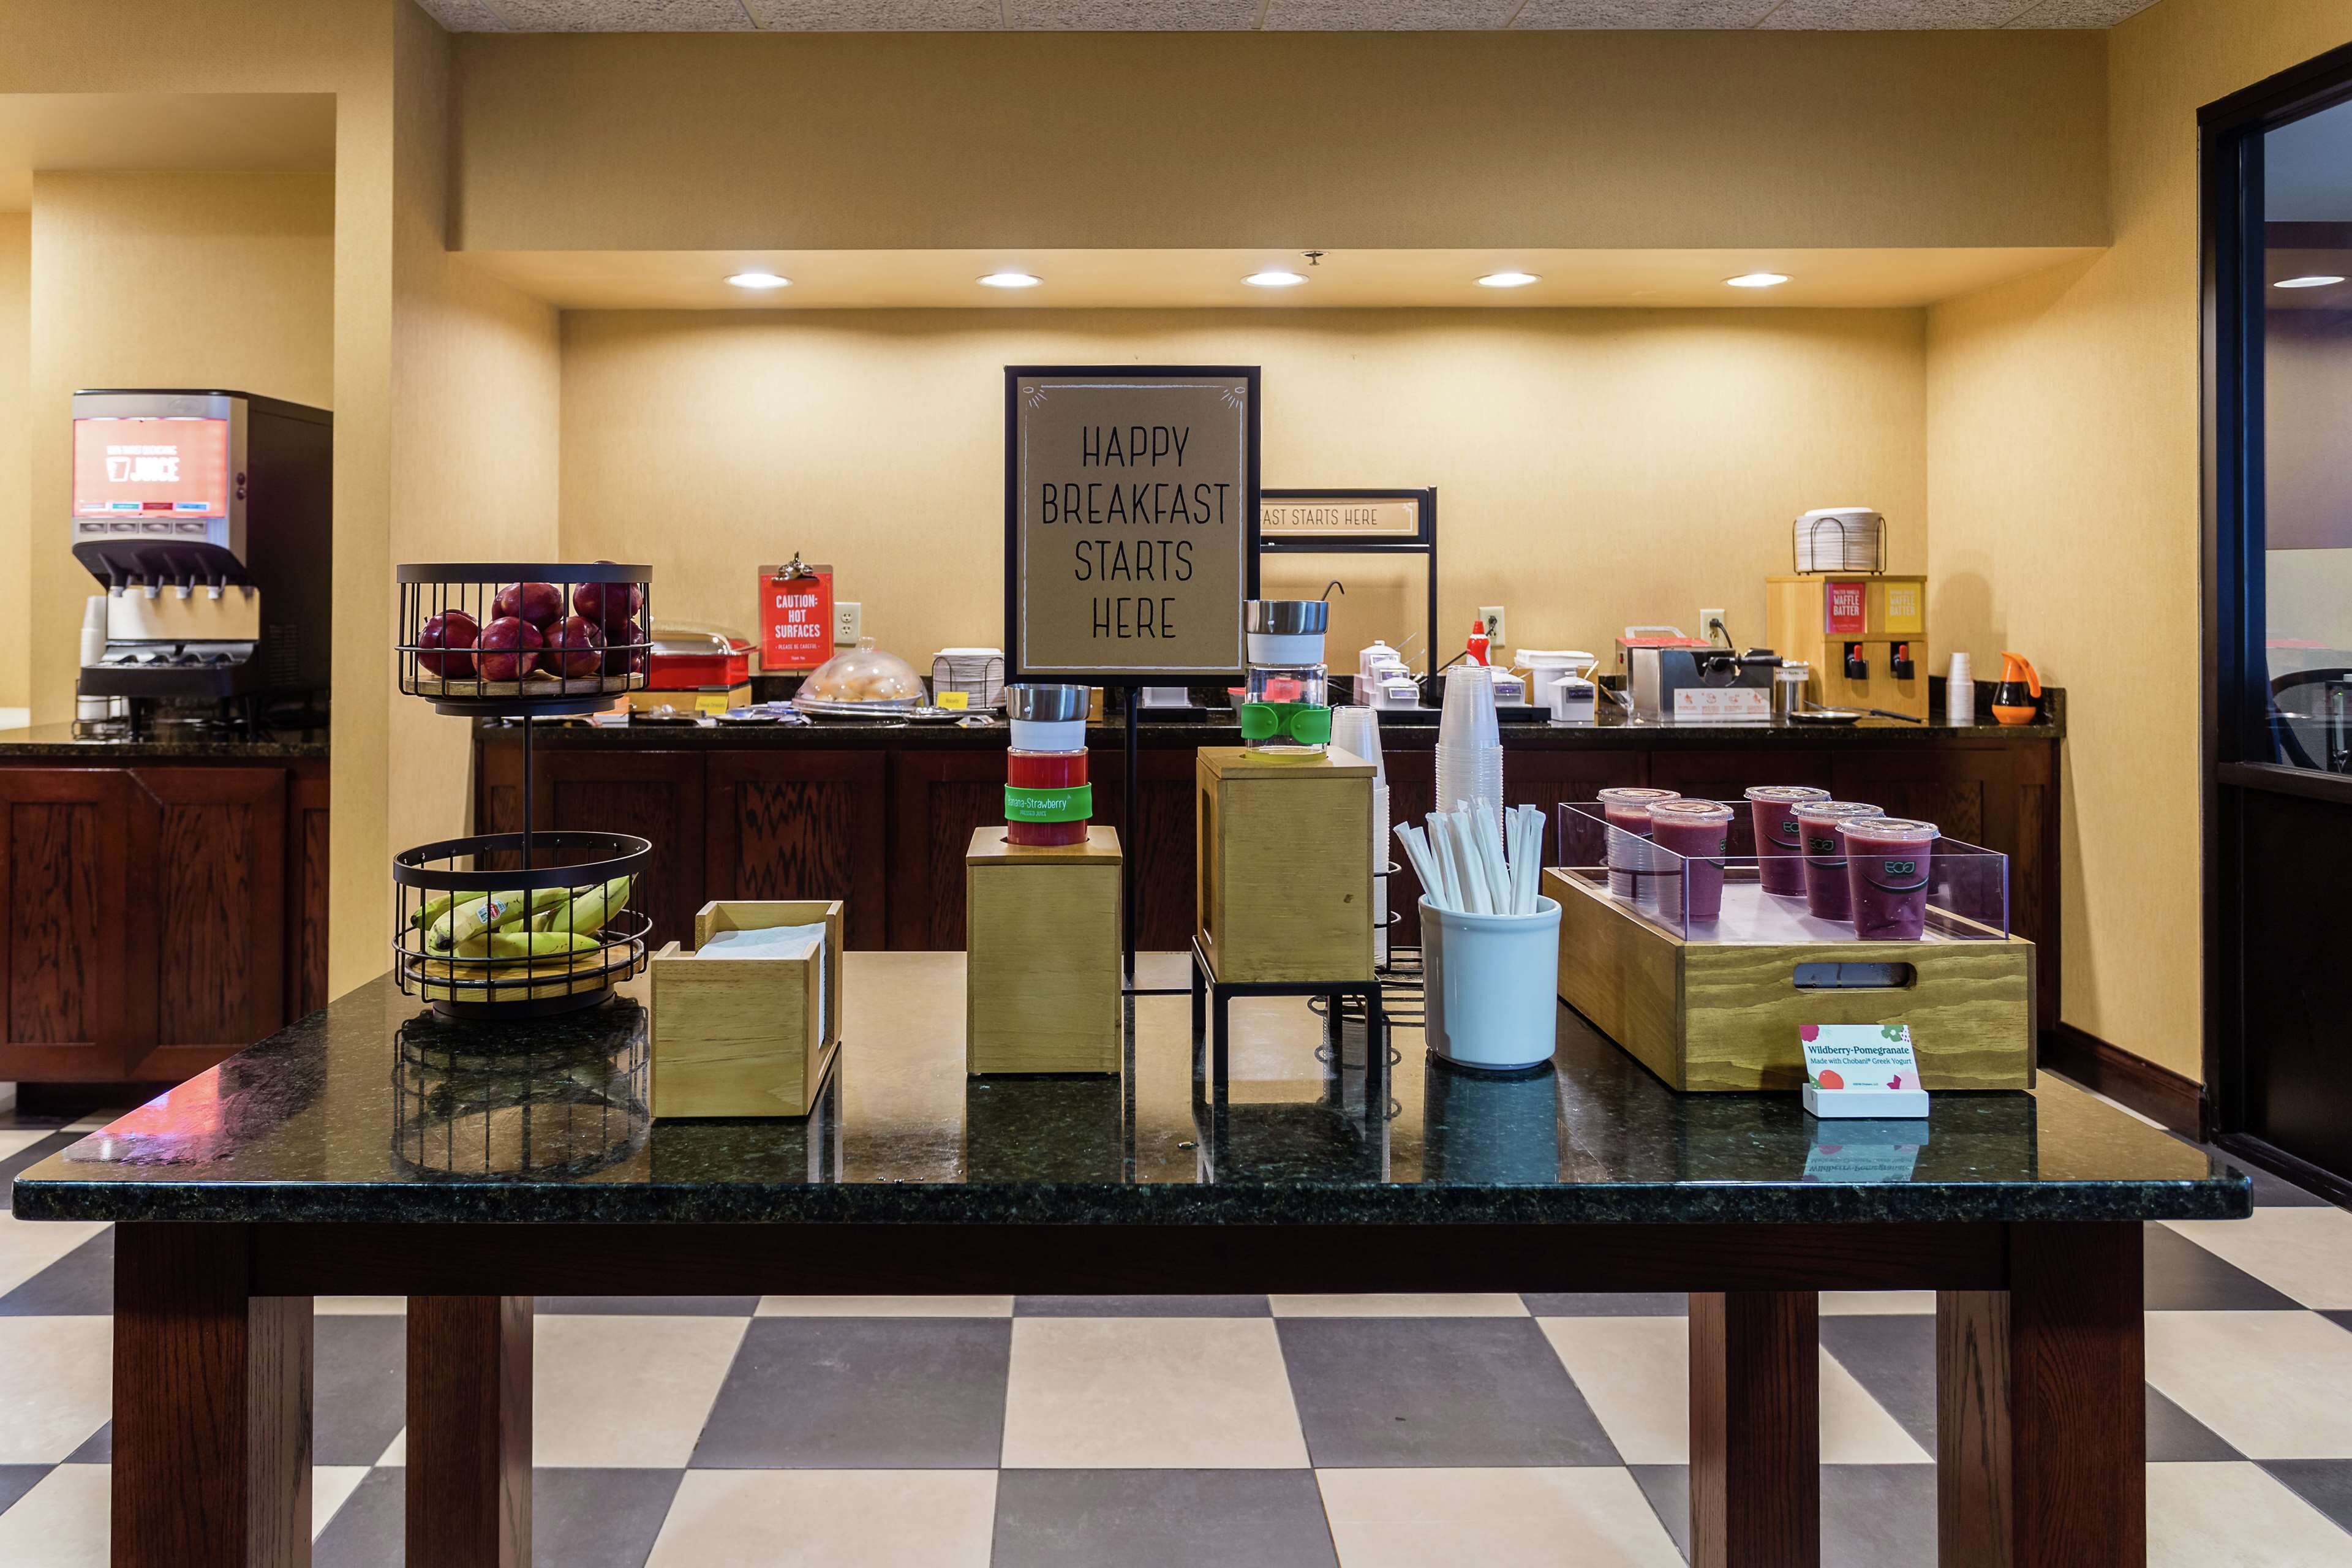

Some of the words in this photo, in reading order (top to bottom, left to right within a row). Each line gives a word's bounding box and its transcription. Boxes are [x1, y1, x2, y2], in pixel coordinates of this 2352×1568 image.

[1083, 426, 1189, 467] HAPPY
[1042, 483, 1231, 524] BREAKFAST
[1261, 509, 1286, 525] AST
[1292, 509, 1339, 525] STARTS
[1345, 509, 1378, 525] HERE
[1075, 540, 1193, 581] STARTS
[776, 594, 818, 608] CAUTION:
[1833, 595, 1860, 606] WAFFLE
[1890, 595, 1915, 606] WAFFLE
[788, 609, 806, 623] HOT
[1093, 597, 1177, 638] HERE
[1833, 606, 1860, 616] BATTER
[1890, 606, 1915, 616] BATTER
[775, 624, 821, 638] SURFACES
[1008, 795, 1067, 811] Banana-Strawberry
[1783, 821, 1799, 832] EC
[1808, 1046, 1909, 1055] Wildberry-Pomegranate
